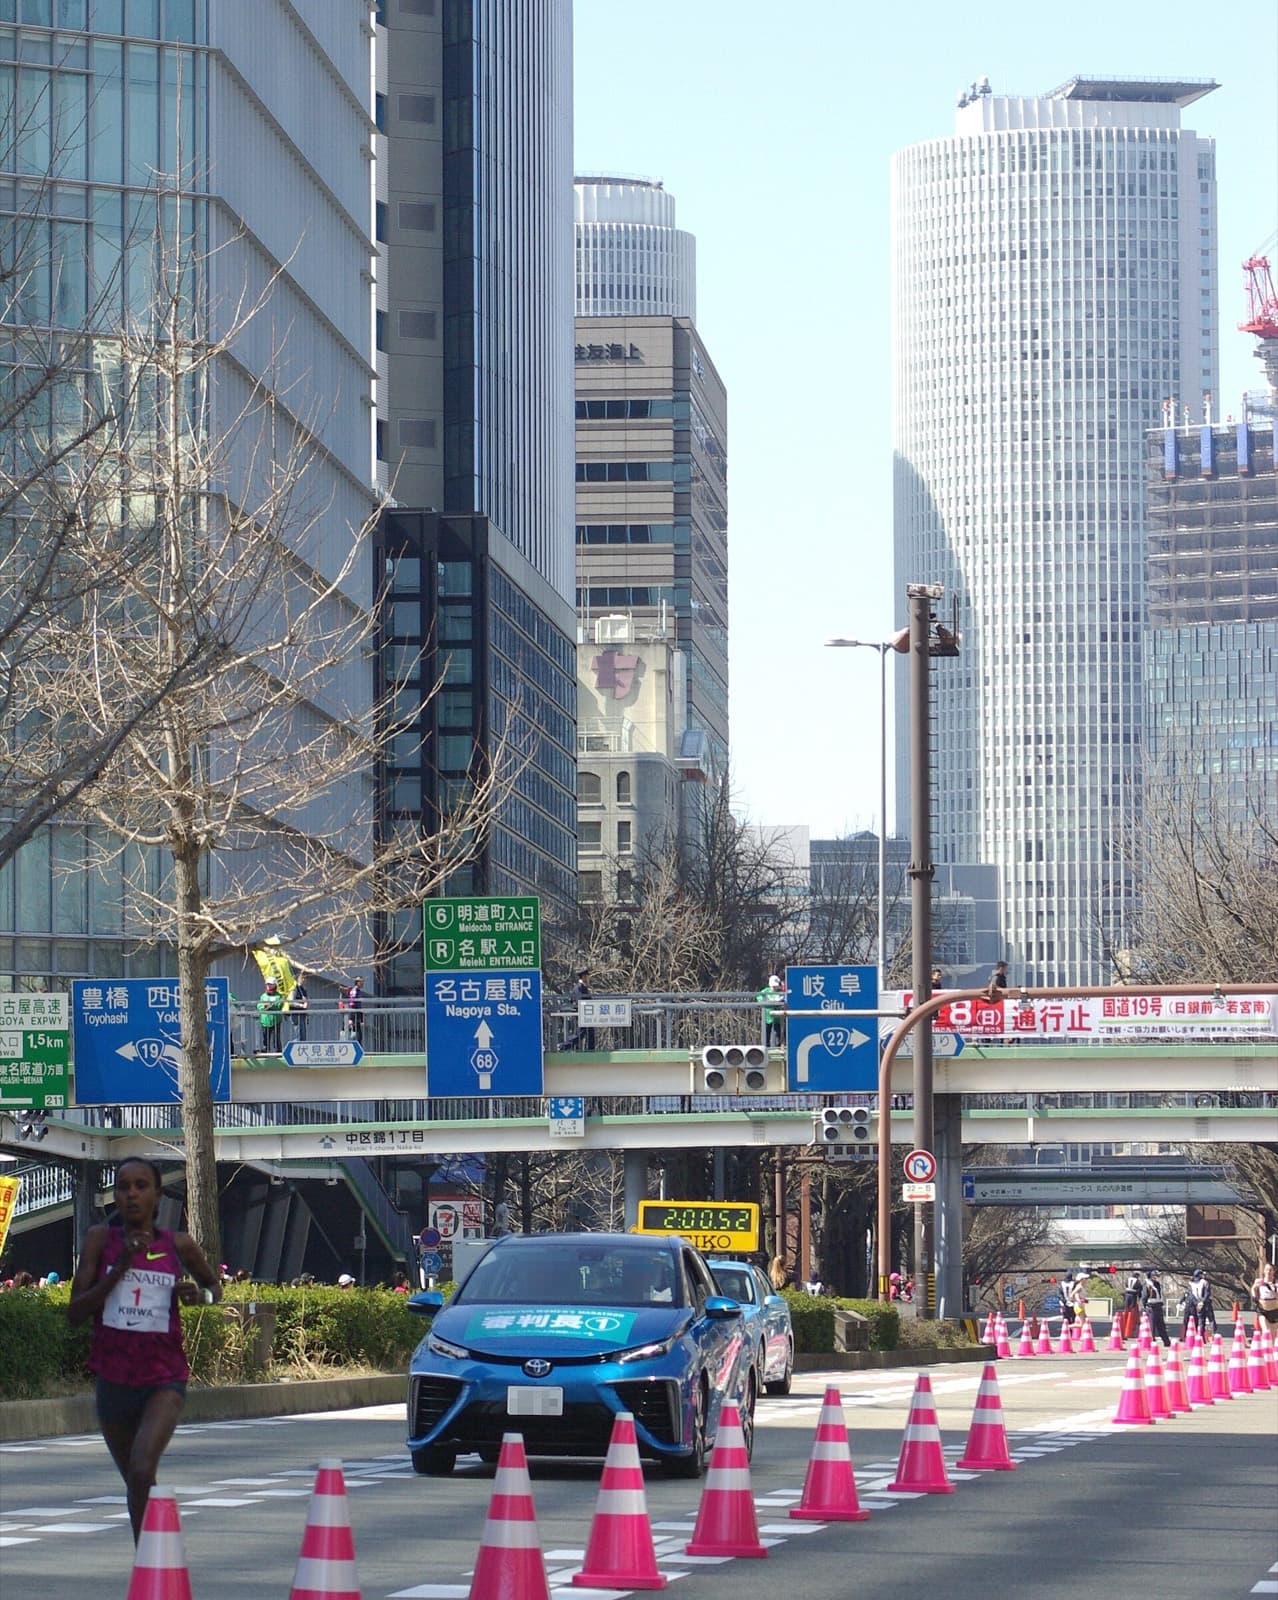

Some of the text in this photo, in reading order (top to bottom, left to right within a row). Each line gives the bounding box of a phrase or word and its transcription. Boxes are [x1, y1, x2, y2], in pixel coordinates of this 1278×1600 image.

[436, 907, 447, 924] 6
[457, 904, 534, 921] 明道町入口
[459, 921, 534, 933] Meidocho ENTRANCE
[436, 942, 448, 958] R
[459, 955, 534, 967] Meieki ENTRANCE
[434, 978, 533, 1002] 名古屋駅
[802, 973, 862, 998] 岐阜
[82, 986, 219, 1010] 豊橋 四市
[820, 1000, 845, 1011] Gifu
[446, 1003, 521, 1019] Nagoya Sta.
[1102, 997, 1163, 1018] 国道19号
[31, 1016, 63, 1026] EXPWY
[82, 1012, 129, 1027] Toyohashi
[1012, 1003, 1092, 1033] 通行止
[827, 1031, 844, 1047] 22
[141, 1042, 159, 1059] 19
[297, 1044, 350, 1057] 伏見通り
[476, 1054, 493, 1069] 68
[46, 1096, 63, 1105] 211
[684, 1235, 732, 1249] IKO
[132, 1288, 142, 1307] 1
[118, 1306, 154, 1317] KIRWA
